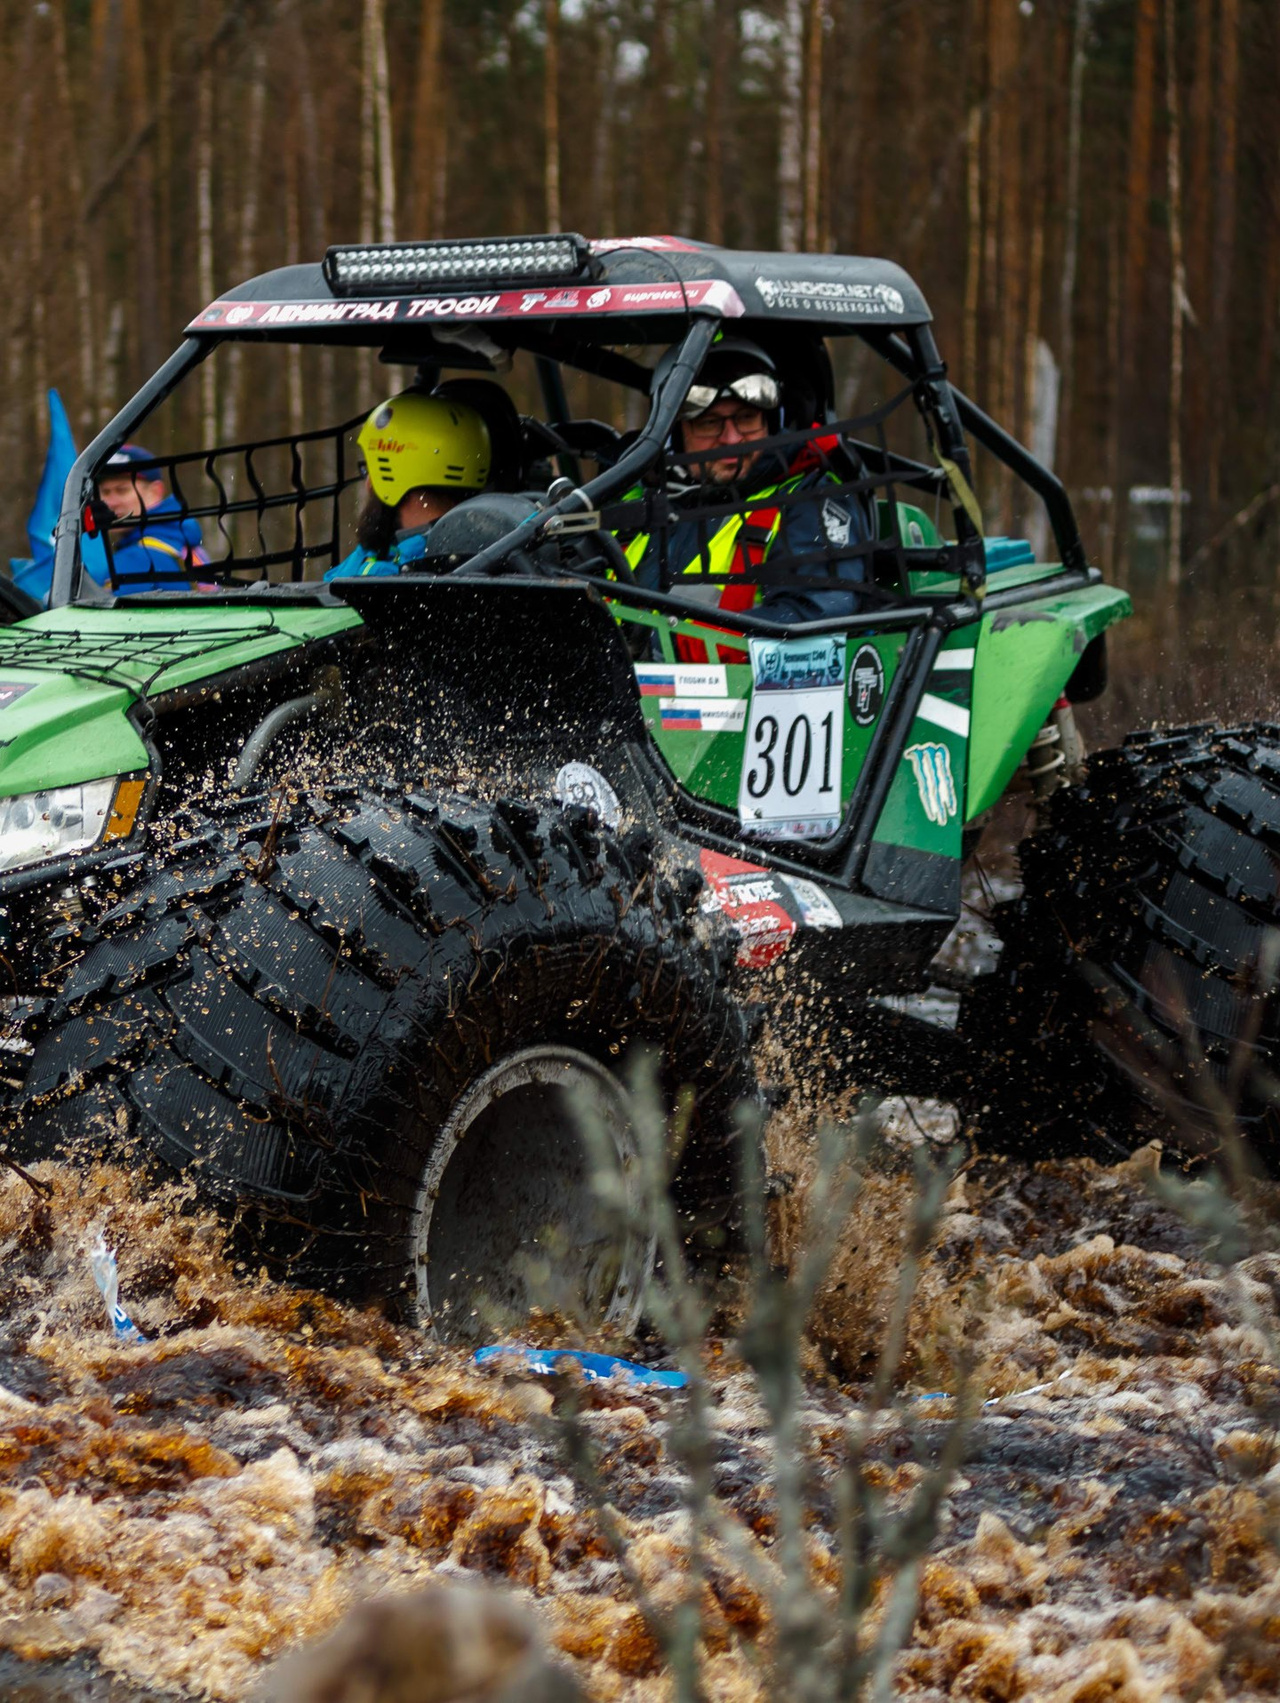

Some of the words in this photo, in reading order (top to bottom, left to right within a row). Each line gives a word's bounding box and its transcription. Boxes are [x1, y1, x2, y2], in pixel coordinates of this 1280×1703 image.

[258, 301, 397, 323] ЛЕНИНГРАД
[406, 295, 501, 317] ТРОФИ
[746, 711, 834, 799] 301
